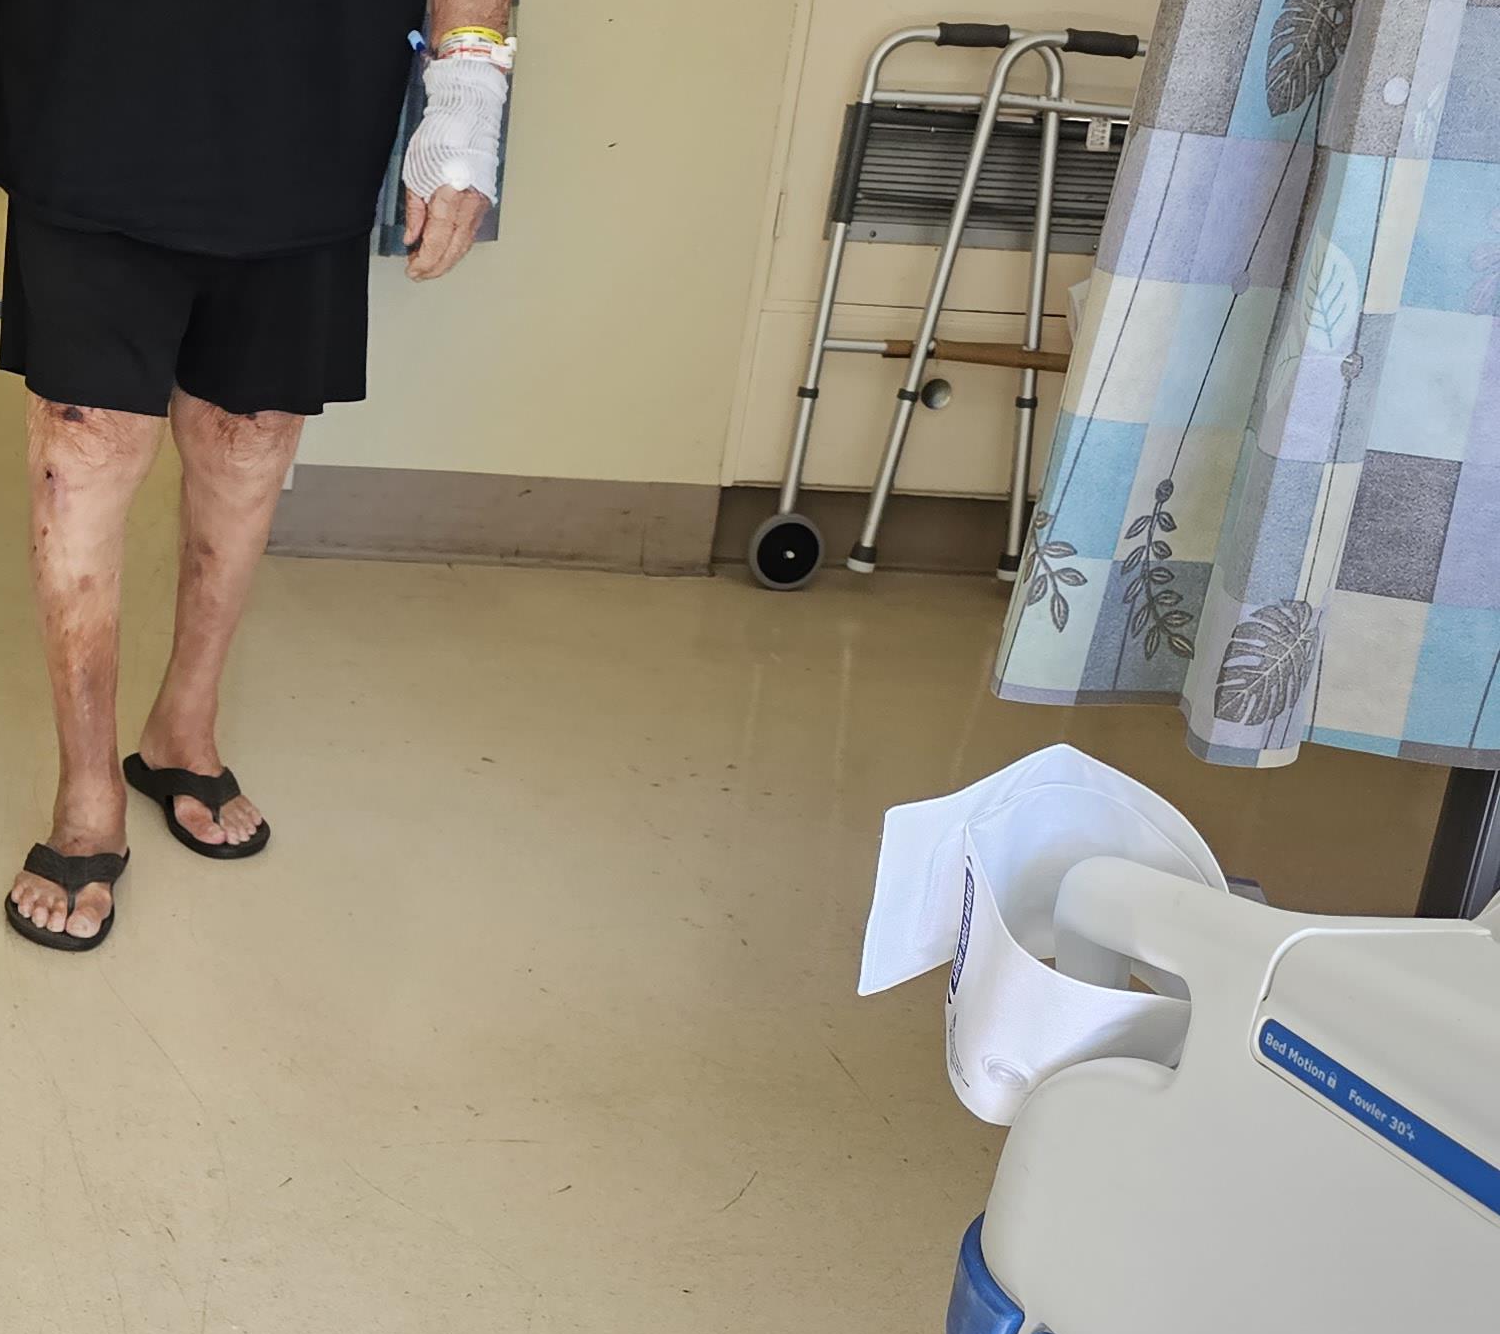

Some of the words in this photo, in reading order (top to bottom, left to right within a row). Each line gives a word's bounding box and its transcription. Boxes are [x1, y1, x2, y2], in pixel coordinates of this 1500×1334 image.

[1264, 1032, 1288, 1056] Bed
[1288, 1048, 1326, 1083] Motion
[1348, 1088, 1388, 1123] Fowler
